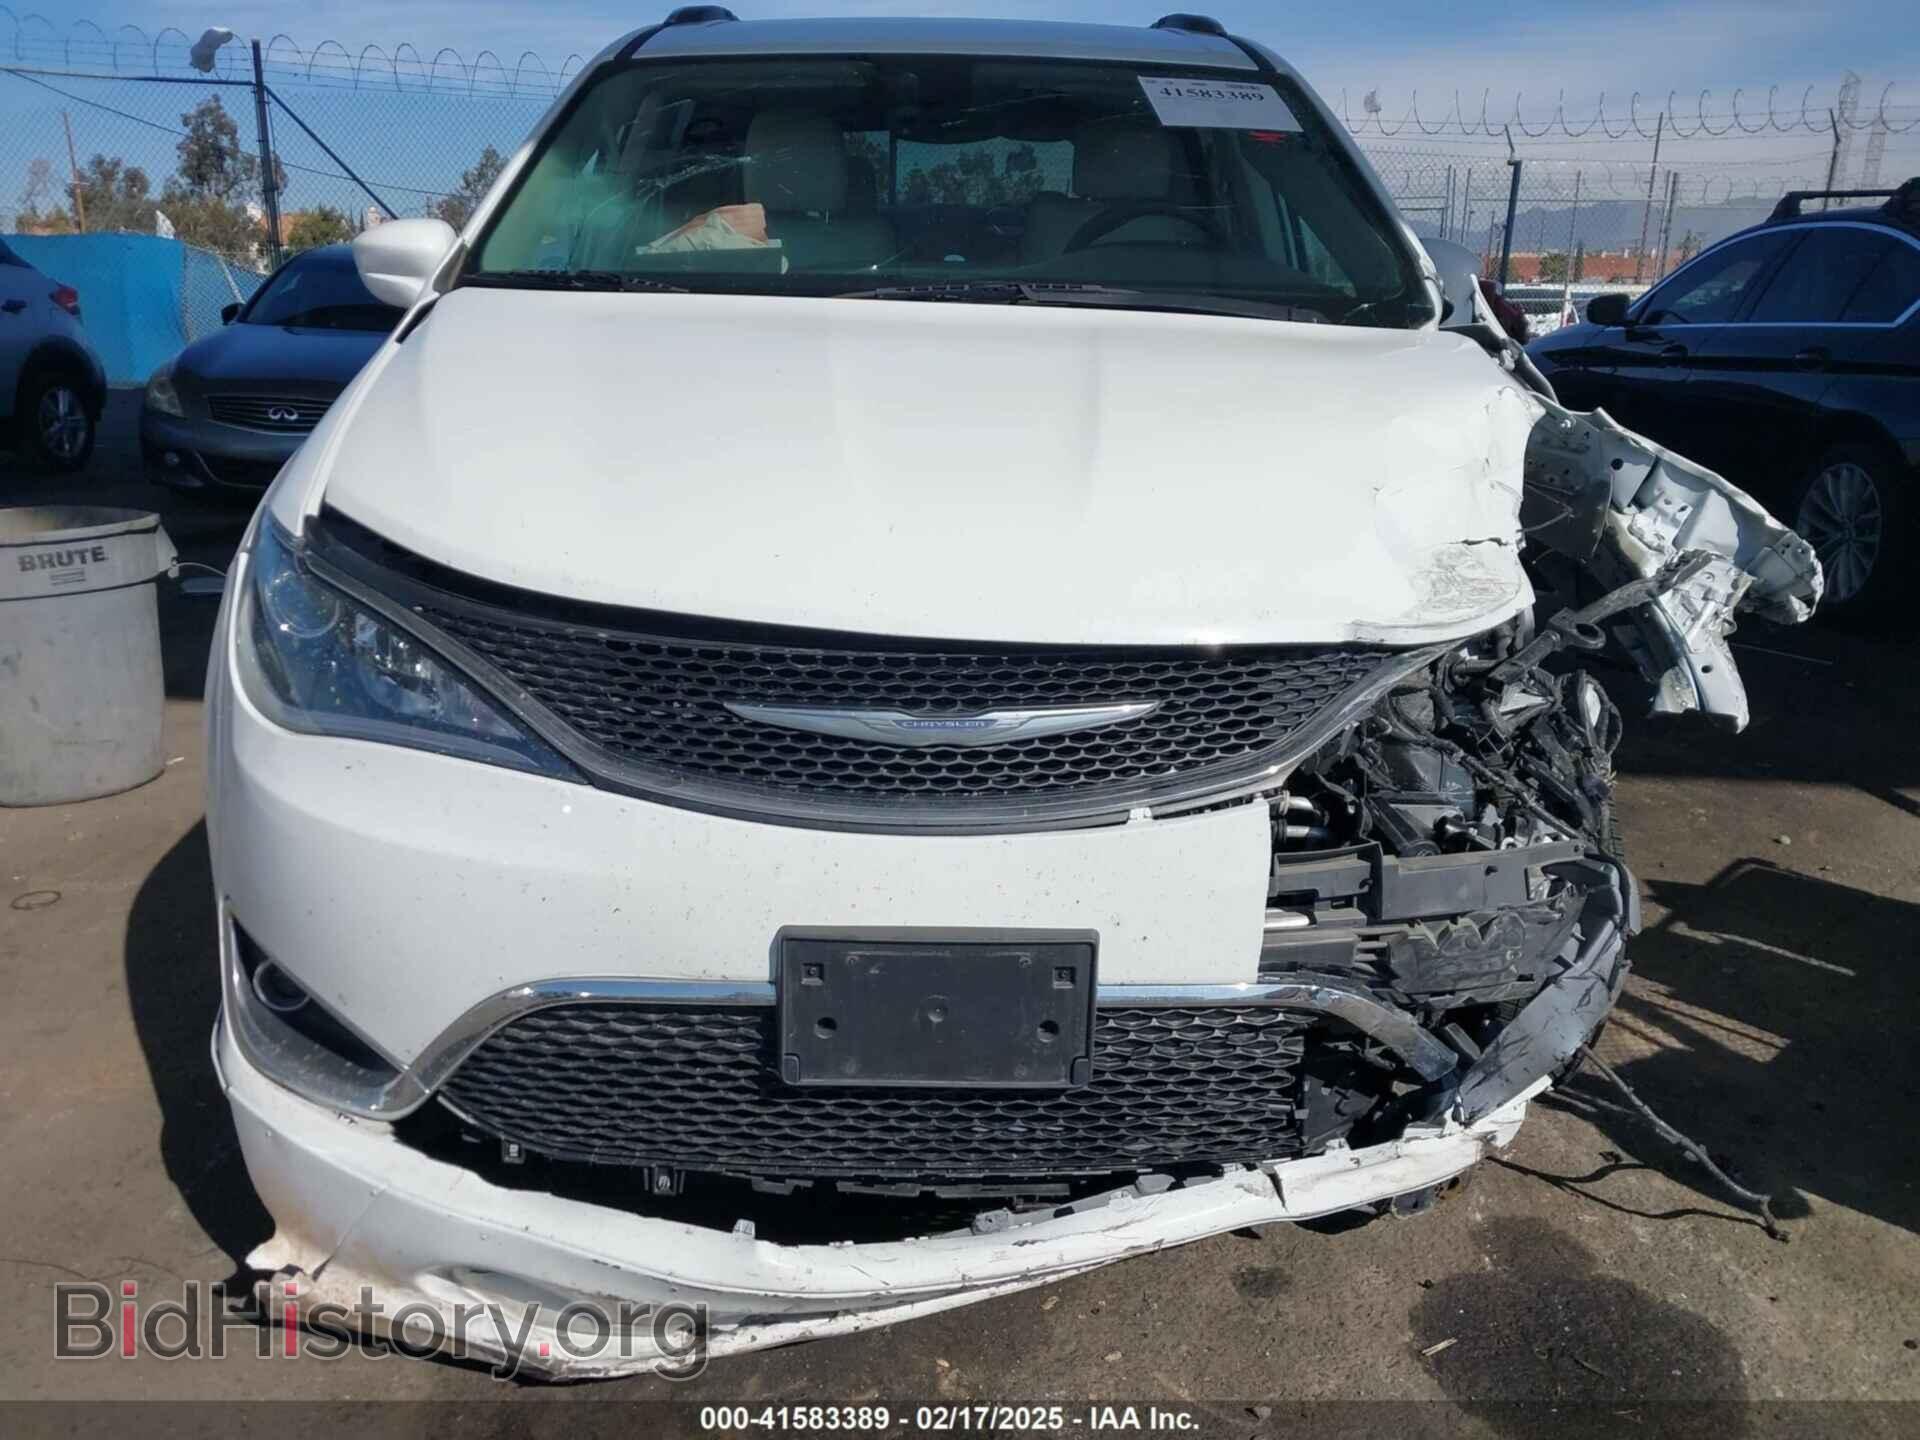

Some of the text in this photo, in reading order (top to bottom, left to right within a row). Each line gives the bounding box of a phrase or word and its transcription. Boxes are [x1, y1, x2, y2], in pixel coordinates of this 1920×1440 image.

[1159, 86, 1265, 101] 41583389
[18, 546, 105, 571] BRUTE
[903, 720, 985, 728] CHRYSLER
